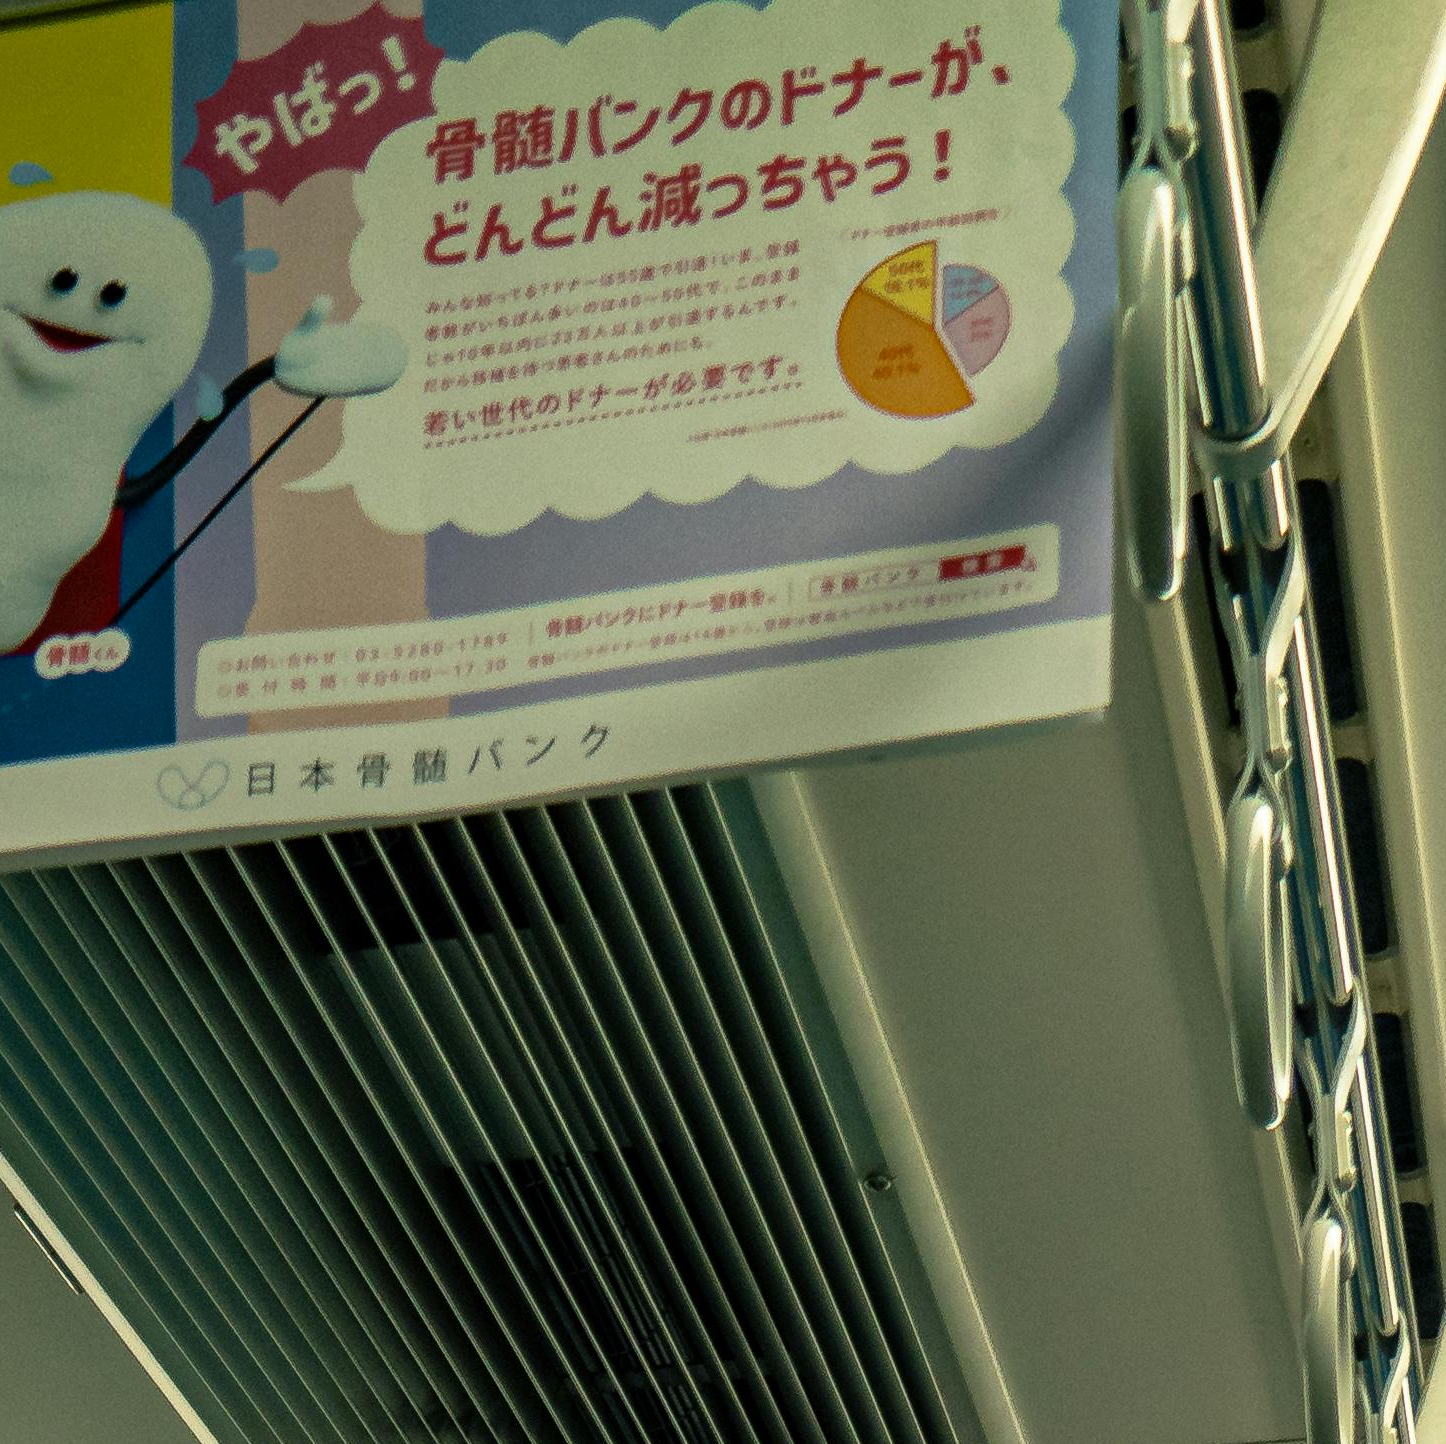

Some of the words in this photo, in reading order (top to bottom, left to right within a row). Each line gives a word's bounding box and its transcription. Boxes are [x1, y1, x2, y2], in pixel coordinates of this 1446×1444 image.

[213, 35, 419, 174] やばっ!
[426, 27, 1012, 185] 骨髄バンクのドナーが、
[424, 130, 953, 266] どんどん減っちゃう!
[246, 723, 612, 797] 日本骨髄バンク
